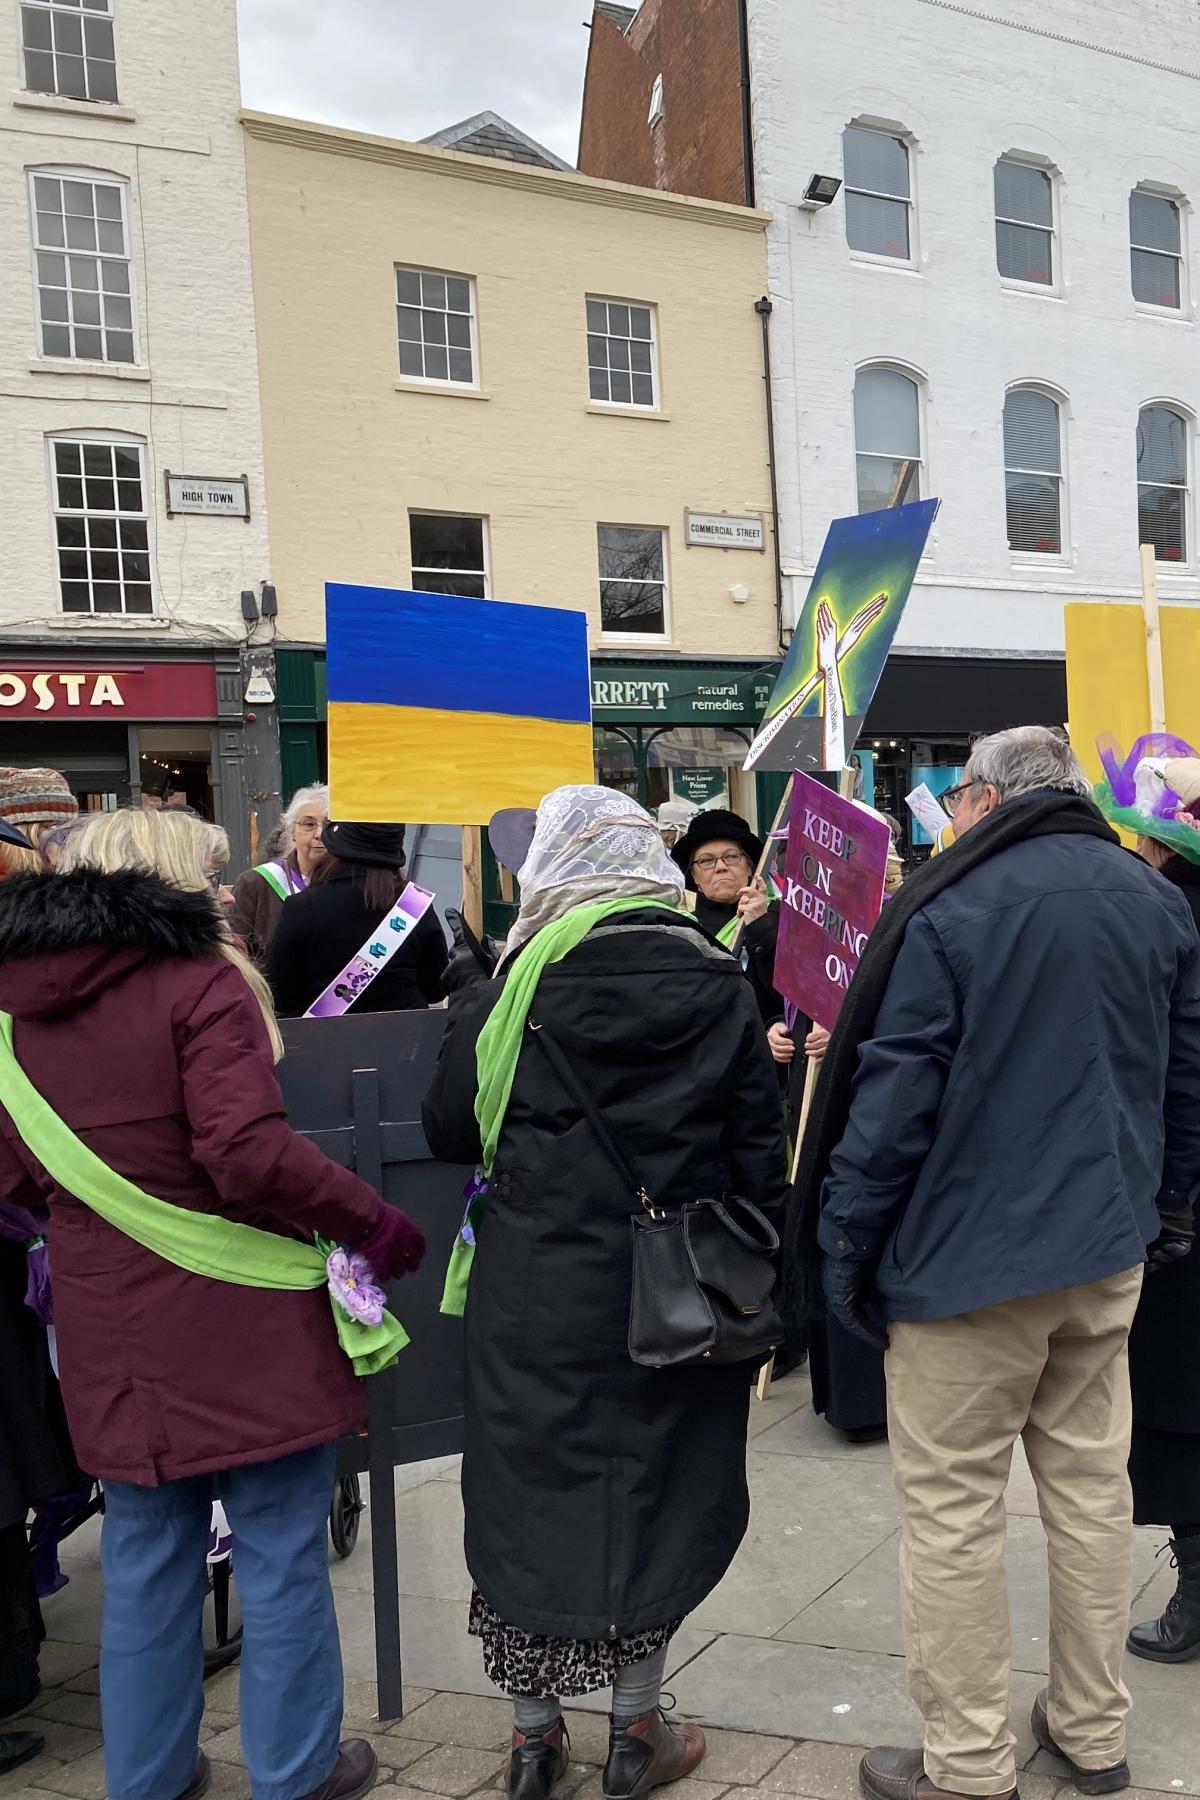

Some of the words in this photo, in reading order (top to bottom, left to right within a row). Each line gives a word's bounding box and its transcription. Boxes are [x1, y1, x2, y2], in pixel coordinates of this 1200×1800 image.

[182, 491, 203, 502] HIGH
[208, 492, 233, 504] TOWN
[691, 523, 733, 536] COMMERCIAL
[737, 528, 760, 538] STREET
[591, 681, 669, 709] RRETT
[698, 684, 738, 696] natural
[692, 698, 744, 711] remedies
[749, 692, 805, 760] DISCRIMINATION
[803, 808, 857, 864] KEEP
[802, 853, 833, 896] ON
